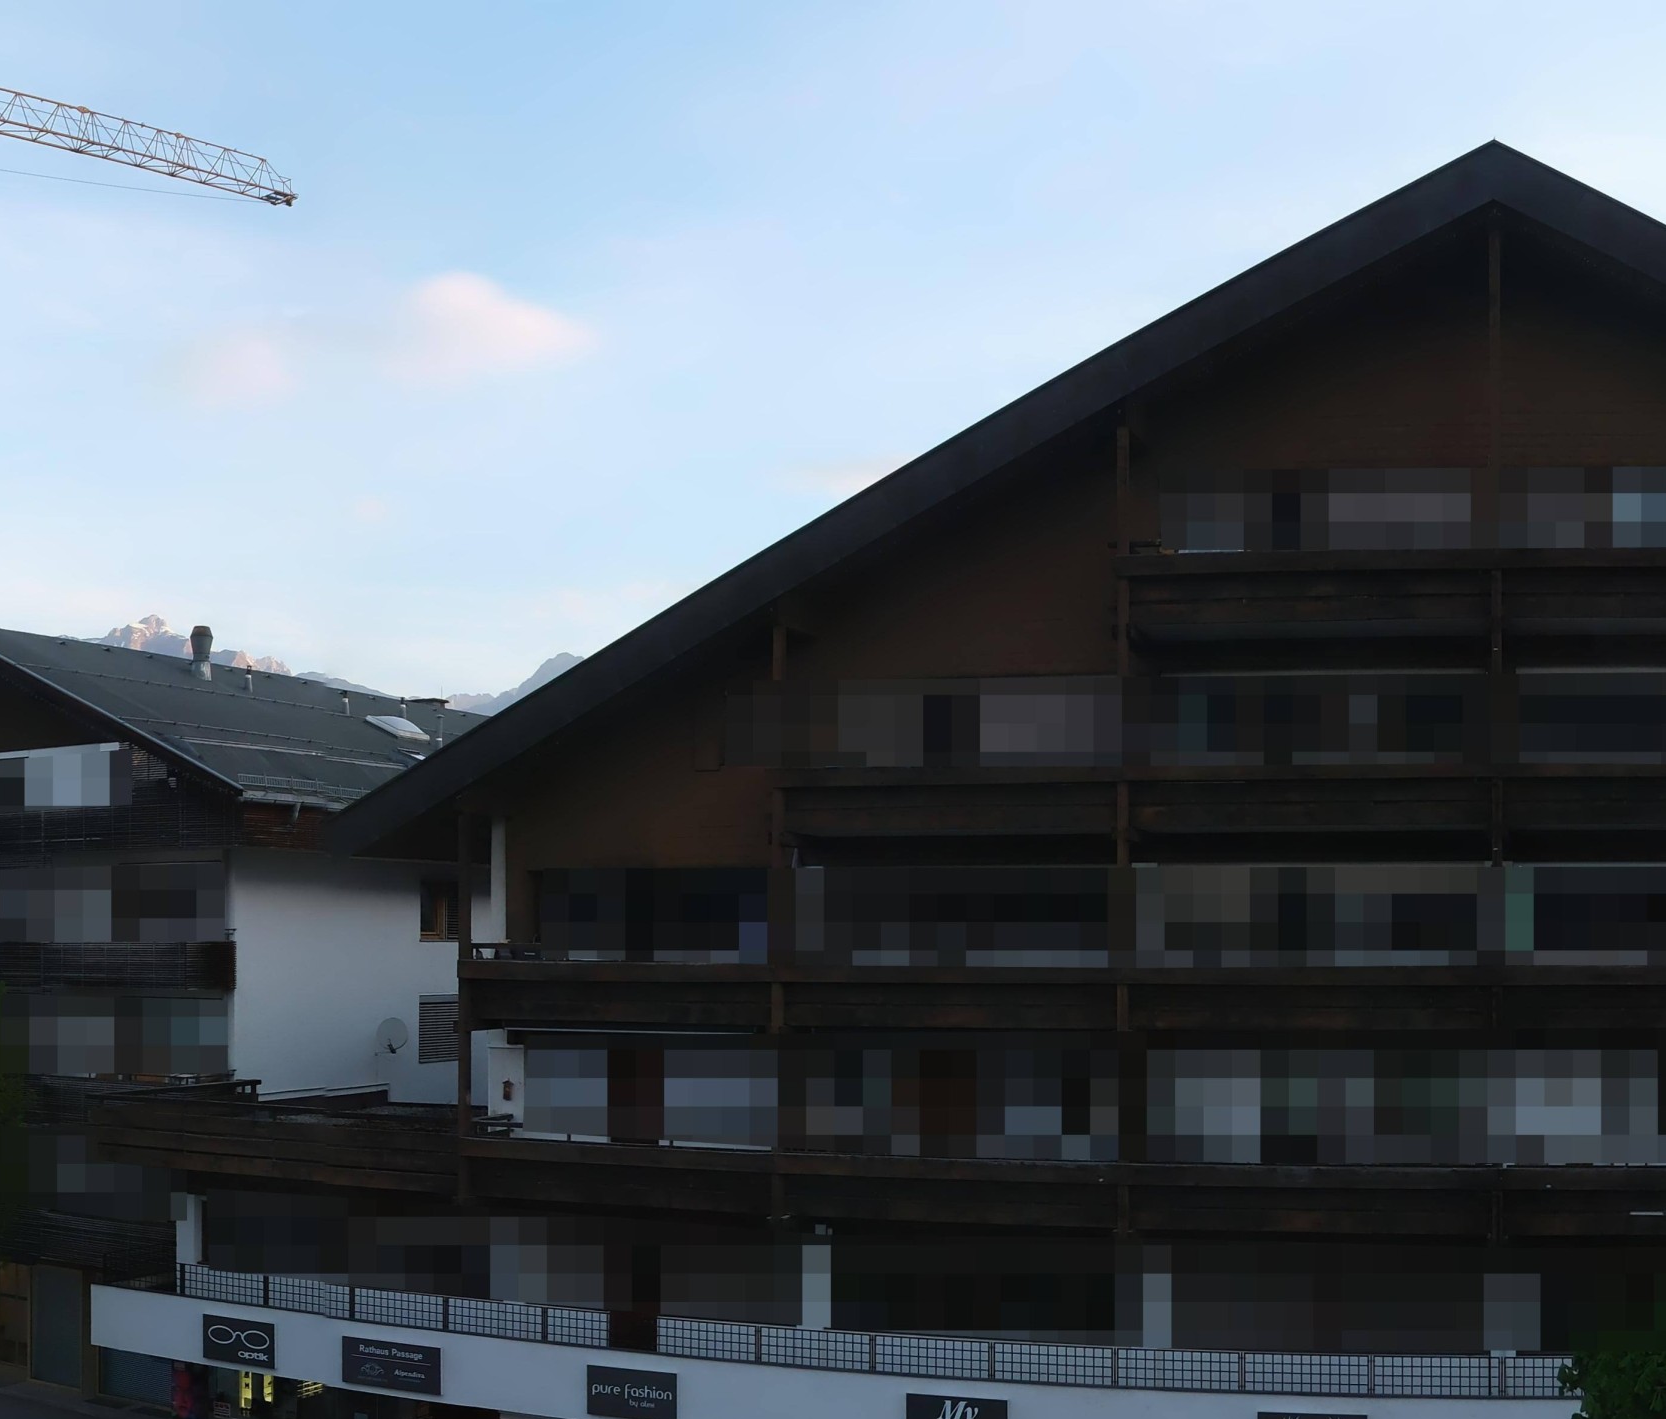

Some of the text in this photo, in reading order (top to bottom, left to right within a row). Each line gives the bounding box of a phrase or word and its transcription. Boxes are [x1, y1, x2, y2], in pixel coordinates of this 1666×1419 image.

[237, 1350, 269, 1361] optik
[359, 1344, 423, 1360] Rathaus Passage
[591, 1383, 672, 1400] pure fashion
